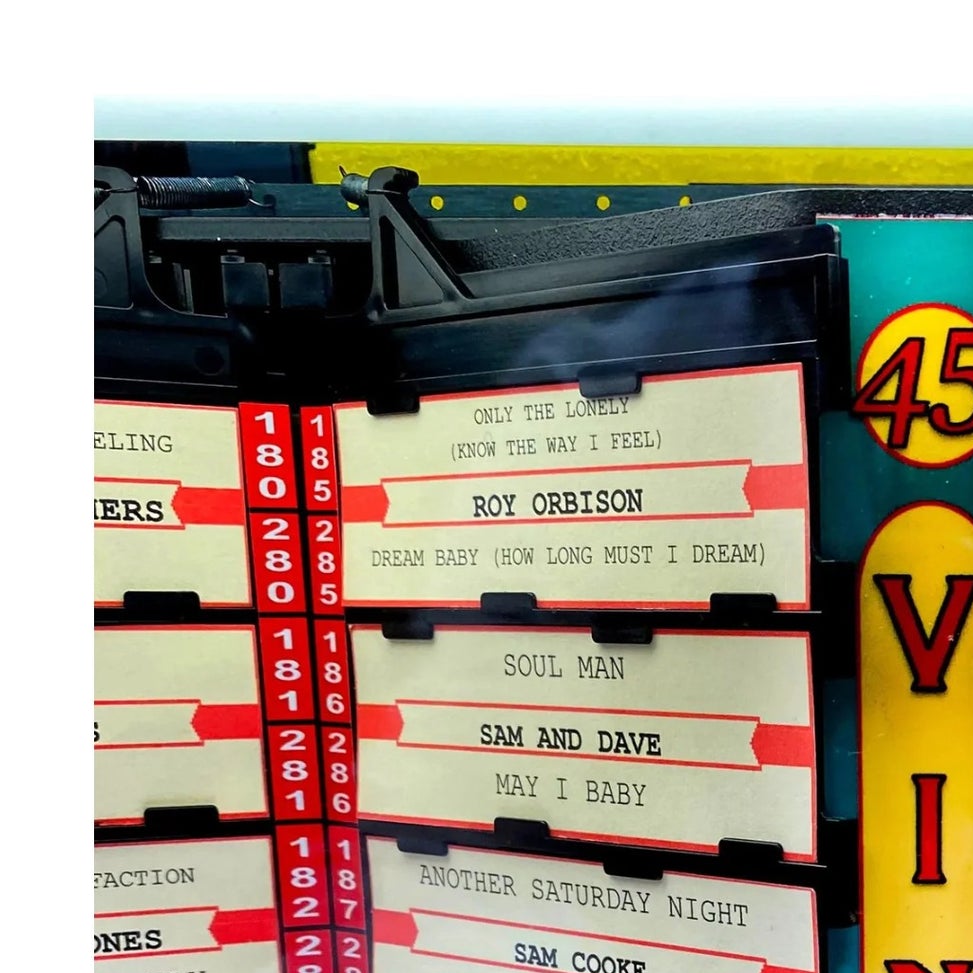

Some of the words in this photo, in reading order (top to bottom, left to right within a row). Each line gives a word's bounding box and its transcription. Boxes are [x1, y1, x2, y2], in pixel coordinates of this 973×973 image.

[452, 441, 495, 461] (KNOW
[506, 439, 536, 455] THE
[546, 436, 577, 453] WAY
[590, 434, 598, 450] I
[611, 430, 661, 449] FEEL)
[474, 406, 512, 424] ONLY
[524, 403, 554, 420] THE
[565, 396, 629, 418] LONELY
[255, 412, 286, 498] 180
[311, 415, 331, 501] 185
[473, 494, 516, 517] ROY
[533, 489, 643, 515] ORBISON
[263, 519, 294, 602] 280
[316, 521, 337, 604] 285
[372, 550, 424, 566] DREAM
[435, 549, 478, 566] BABY
[495, 548, 534, 568] (HOW
[546, 546, 592, 564] LONG
[604, 546, 652, 564] MUST
[668, 545, 677, 563] I
[693, 543, 764, 566] DREAM)
[274, 629, 300, 710] 181
[324, 632, 344, 713] 186
[504, 654, 562, 677] SOUL
[578, 656, 624, 679] MAN
[281, 730, 307, 810] 281
[329, 733, 350, 813] 286
[481, 724, 524, 747] SAM
[537, 727, 582, 750] AND
[598, 731, 661, 756] DAVE
[496, 773, 538, 797] MAY
[557, 778, 567, 800] I
[586, 780, 646, 806] BABY
[291, 837, 318, 917] 182
[338, 840, 357, 918] 187
[420, 864, 516, 896] ANOTHER
[533, 879, 650, 913] SATURDAY
[668, 896, 748, 926] NIGHT
[515, 943, 558, 968] SAM
